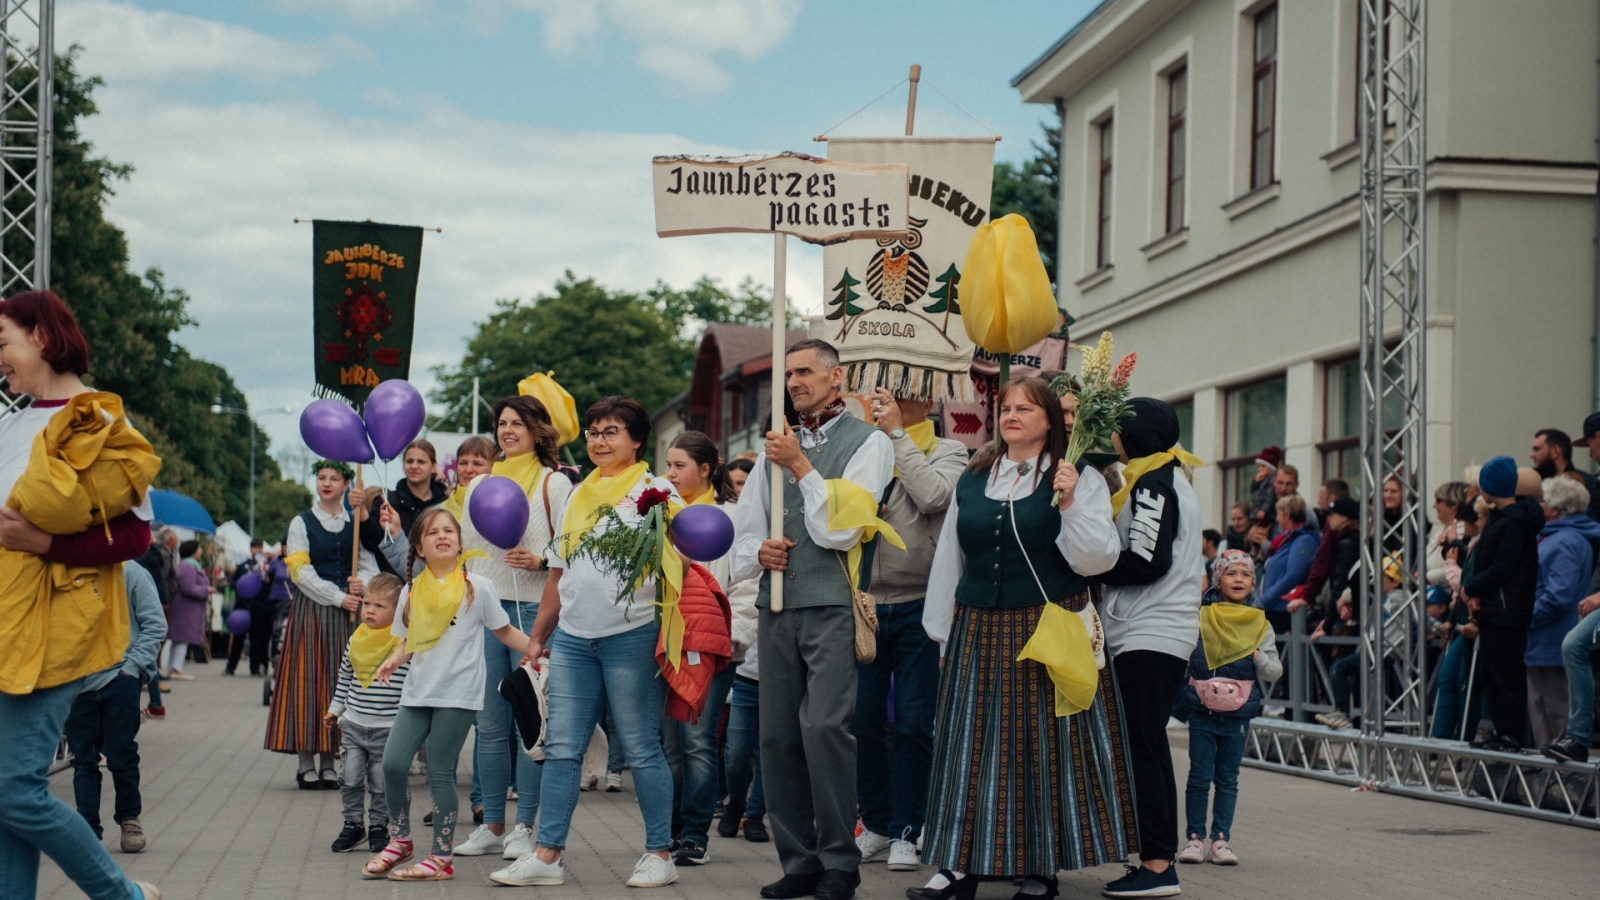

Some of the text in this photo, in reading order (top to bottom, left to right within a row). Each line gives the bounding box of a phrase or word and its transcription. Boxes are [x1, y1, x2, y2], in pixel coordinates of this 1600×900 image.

[666, 166, 836, 198] Jaunbērzes
[768, 197, 890, 231] pagasts
[858, 321, 915, 338] SKOLA
[1129, 488, 1165, 563] NIKE
